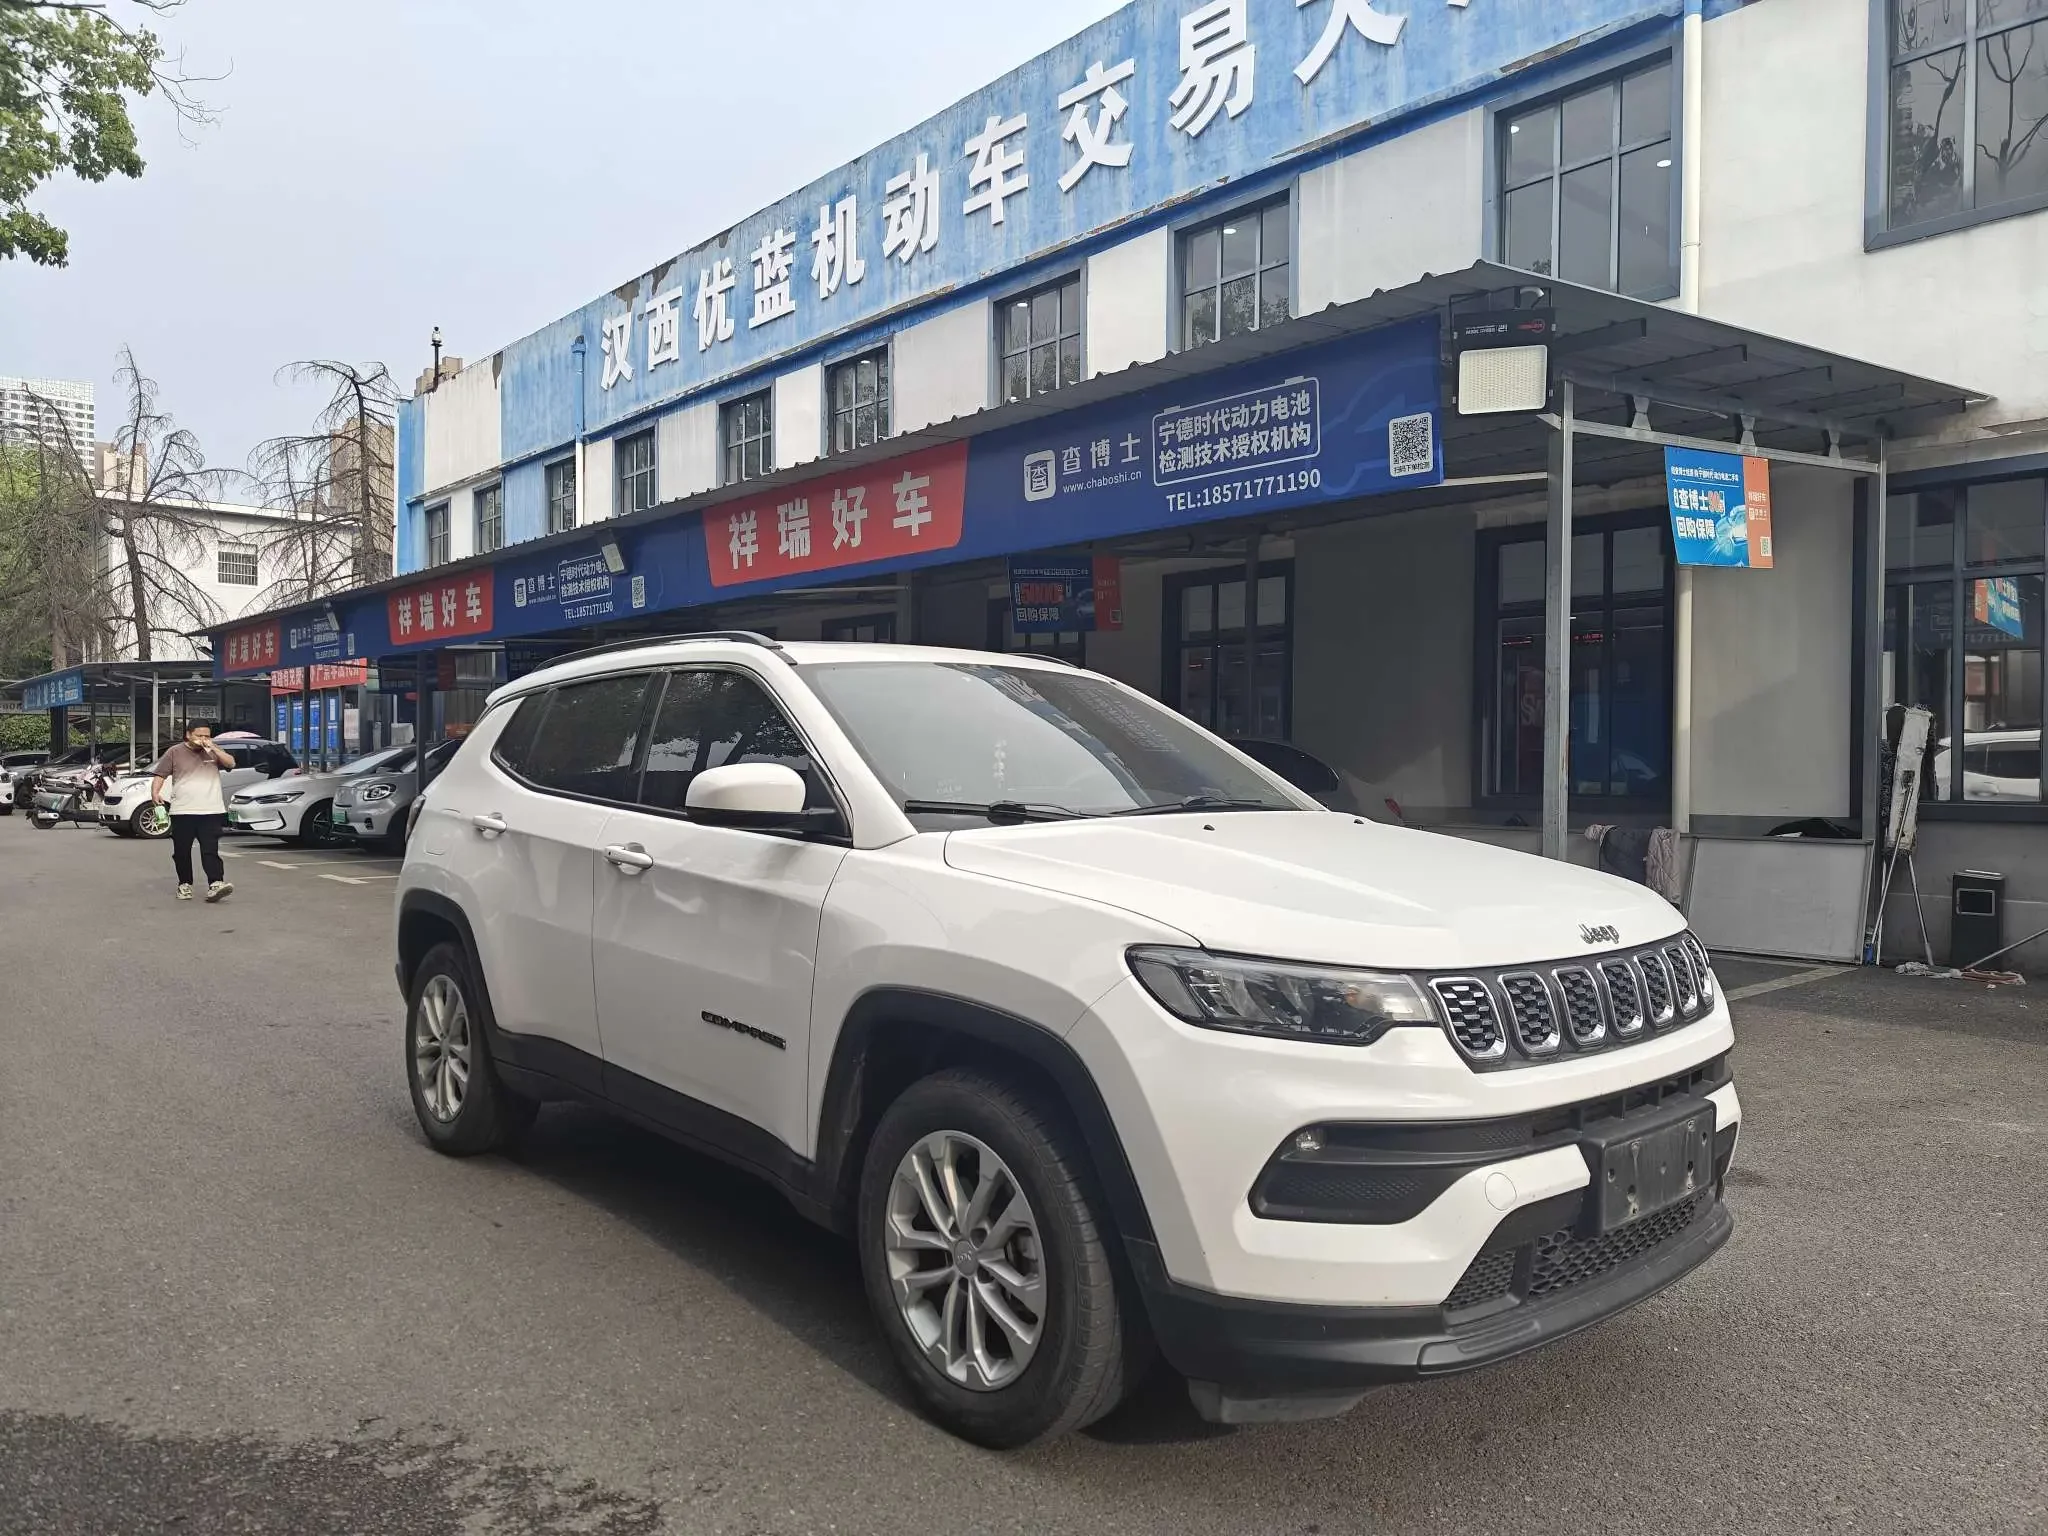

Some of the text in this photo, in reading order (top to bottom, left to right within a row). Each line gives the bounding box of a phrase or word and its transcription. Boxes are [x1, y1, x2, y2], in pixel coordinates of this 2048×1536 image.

[1159, 390, 1311, 446] 宁德时代动力电池
[1061, 432, 1141, 476] 查博士
[1159, 421, 1311, 474] 检测技术授权机构
[1063, 470, 1142, 493] www.chaboshi.cn
[1166, 468, 1322, 513] TEL:18571771190
[728, 471, 932, 570] 祥瑞好车
[1676, 516, 1716, 539] 回购保障
[398, 581, 482, 635] 祥瑞好车
[229, 630, 275, 665] 祥瑞好车
[1578, 923, 1620, 944] Jeep
